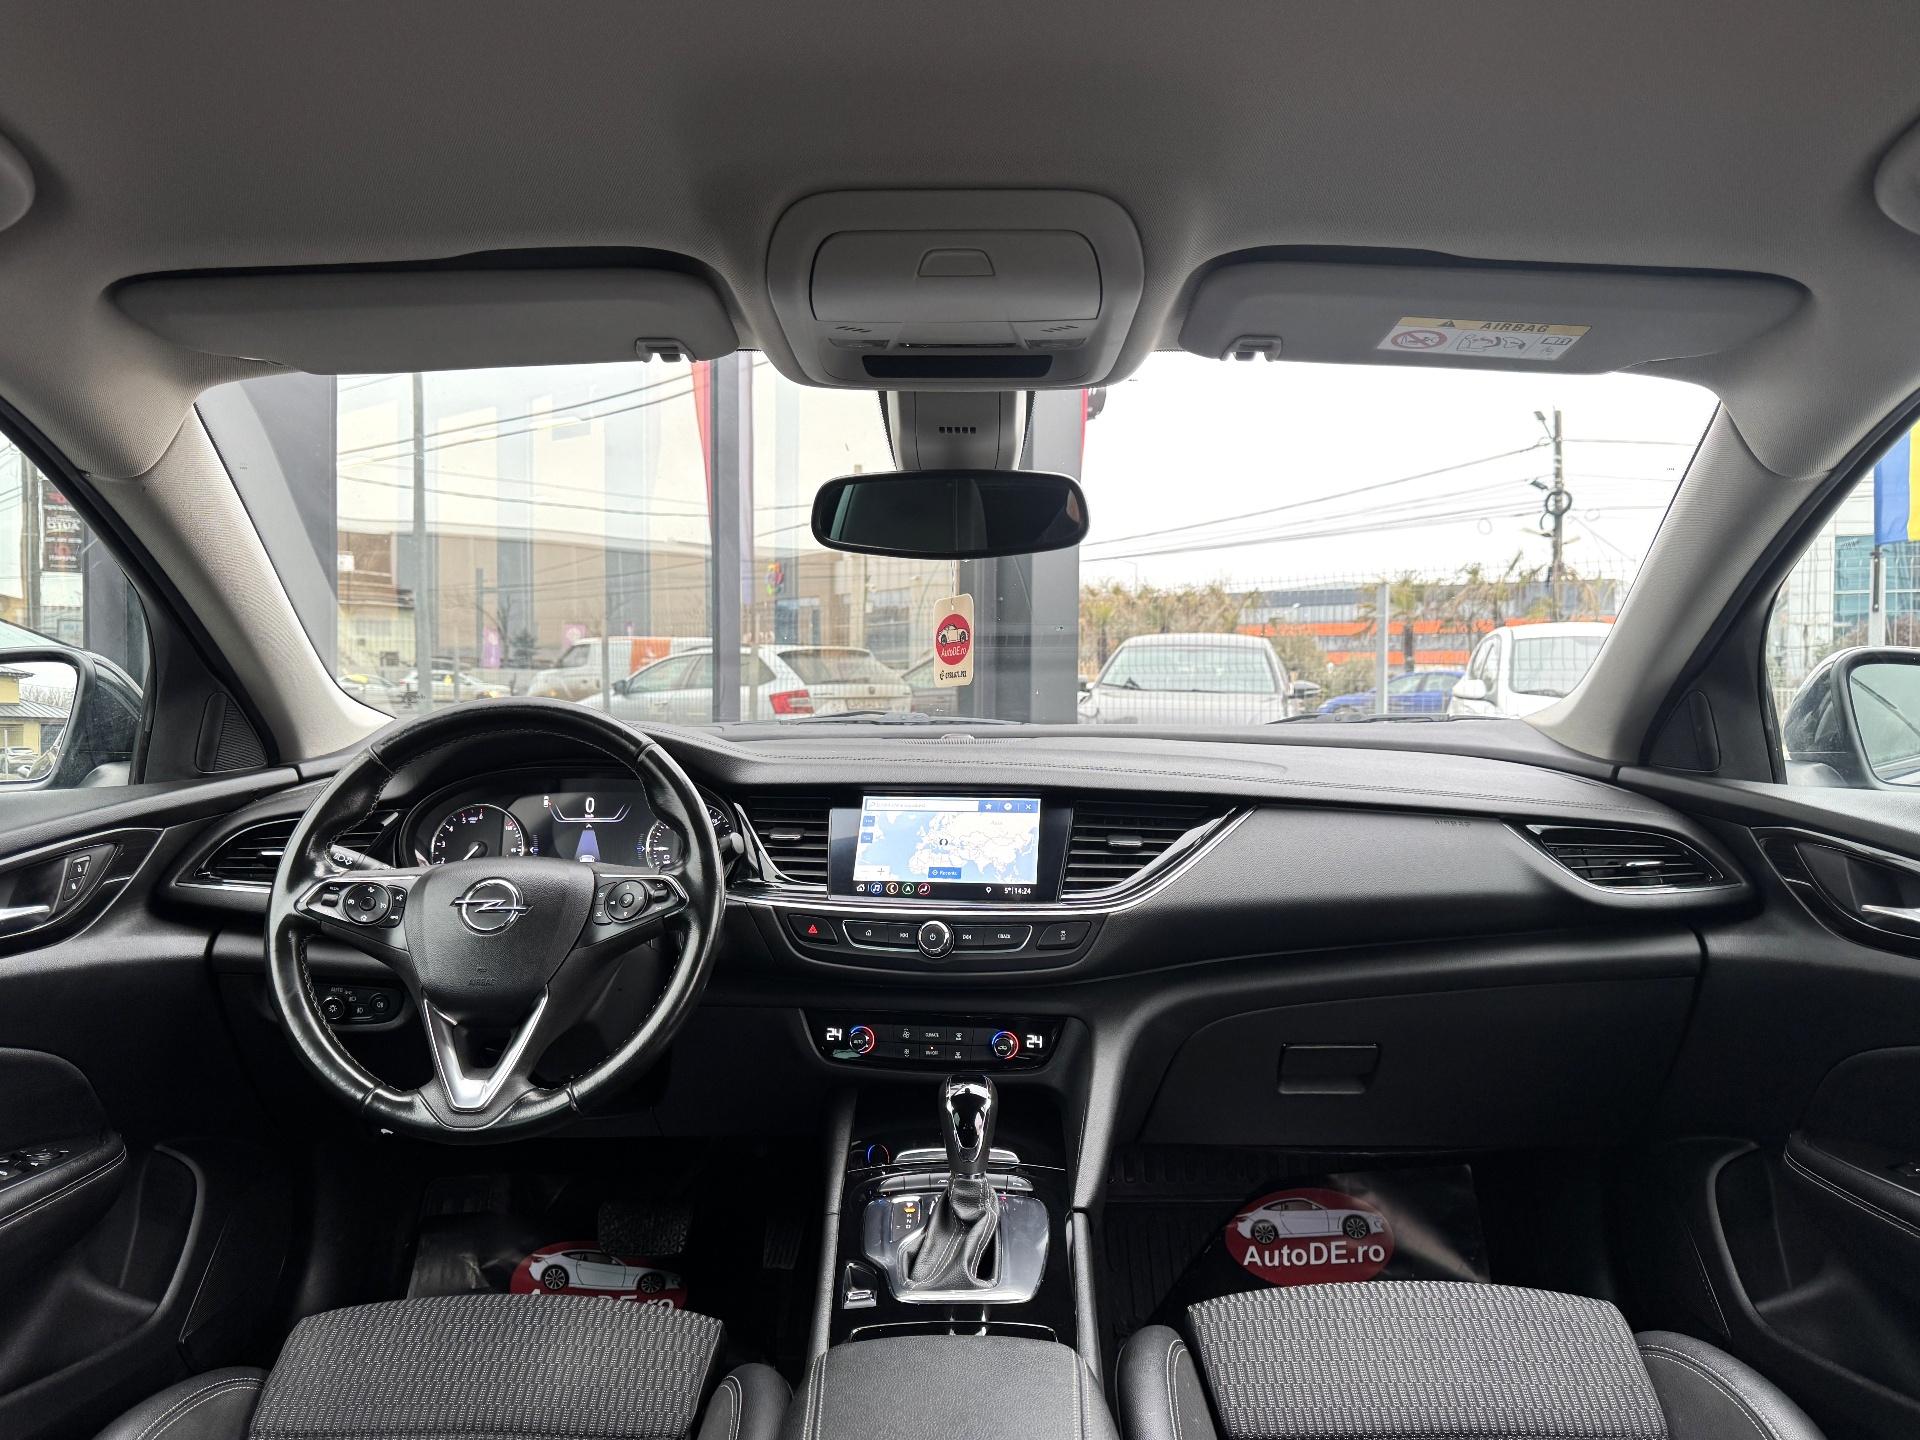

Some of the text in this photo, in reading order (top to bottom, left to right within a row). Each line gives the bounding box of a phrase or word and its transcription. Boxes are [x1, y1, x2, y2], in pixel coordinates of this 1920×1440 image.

[1480, 321, 1549, 333] AIRBAG
[941, 645, 967, 657] AutoDE.ro
[585, 797, 595, 813] 0
[1014, 887, 1031, 895] 14:24
[826, 1027, 842, 1041] 24
[1026, 1034, 1043, 1048] 24
[1243, 1240, 1385, 1267] AutoDE.ro
